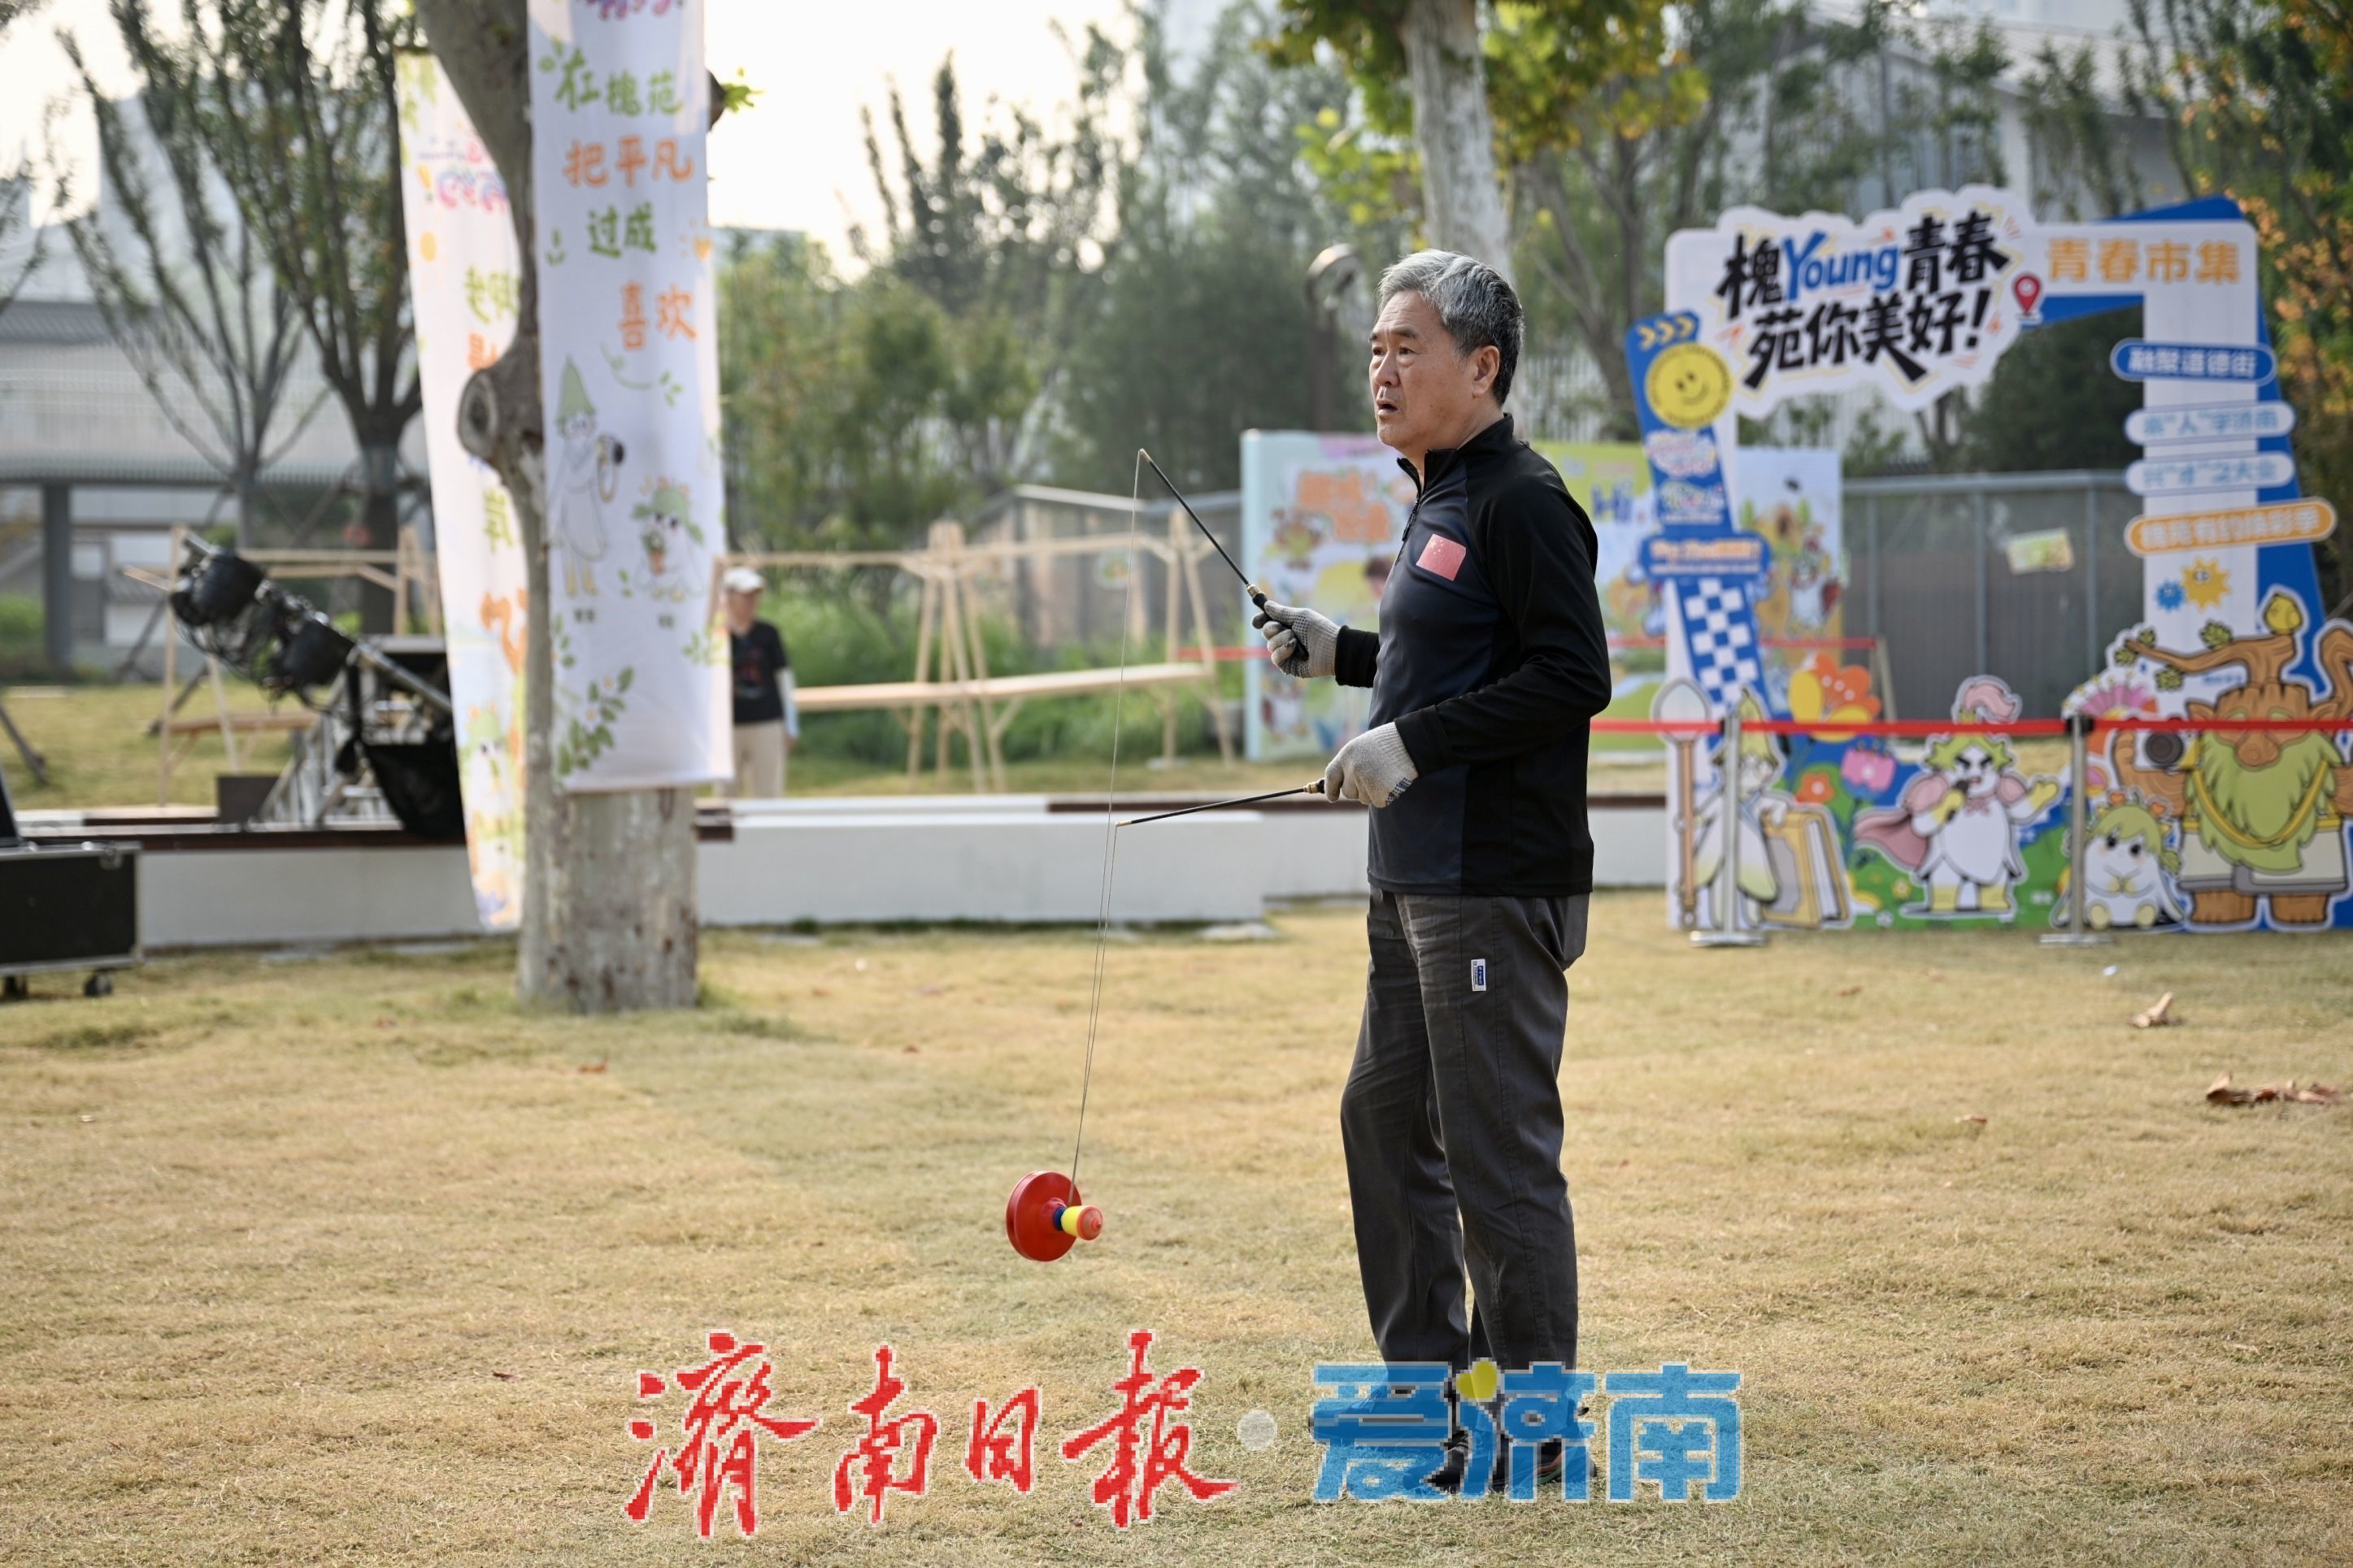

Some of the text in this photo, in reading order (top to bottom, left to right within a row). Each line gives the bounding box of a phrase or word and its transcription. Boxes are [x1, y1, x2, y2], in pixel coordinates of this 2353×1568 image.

[563, 135, 694, 187] 把平凡
[586, 201, 658, 258] 过成
[1716, 211, 2011, 319] 槐Young青春
[2047, 237, 2242, 284] 青春市集
[619, 280, 697, 351] 喜欢
